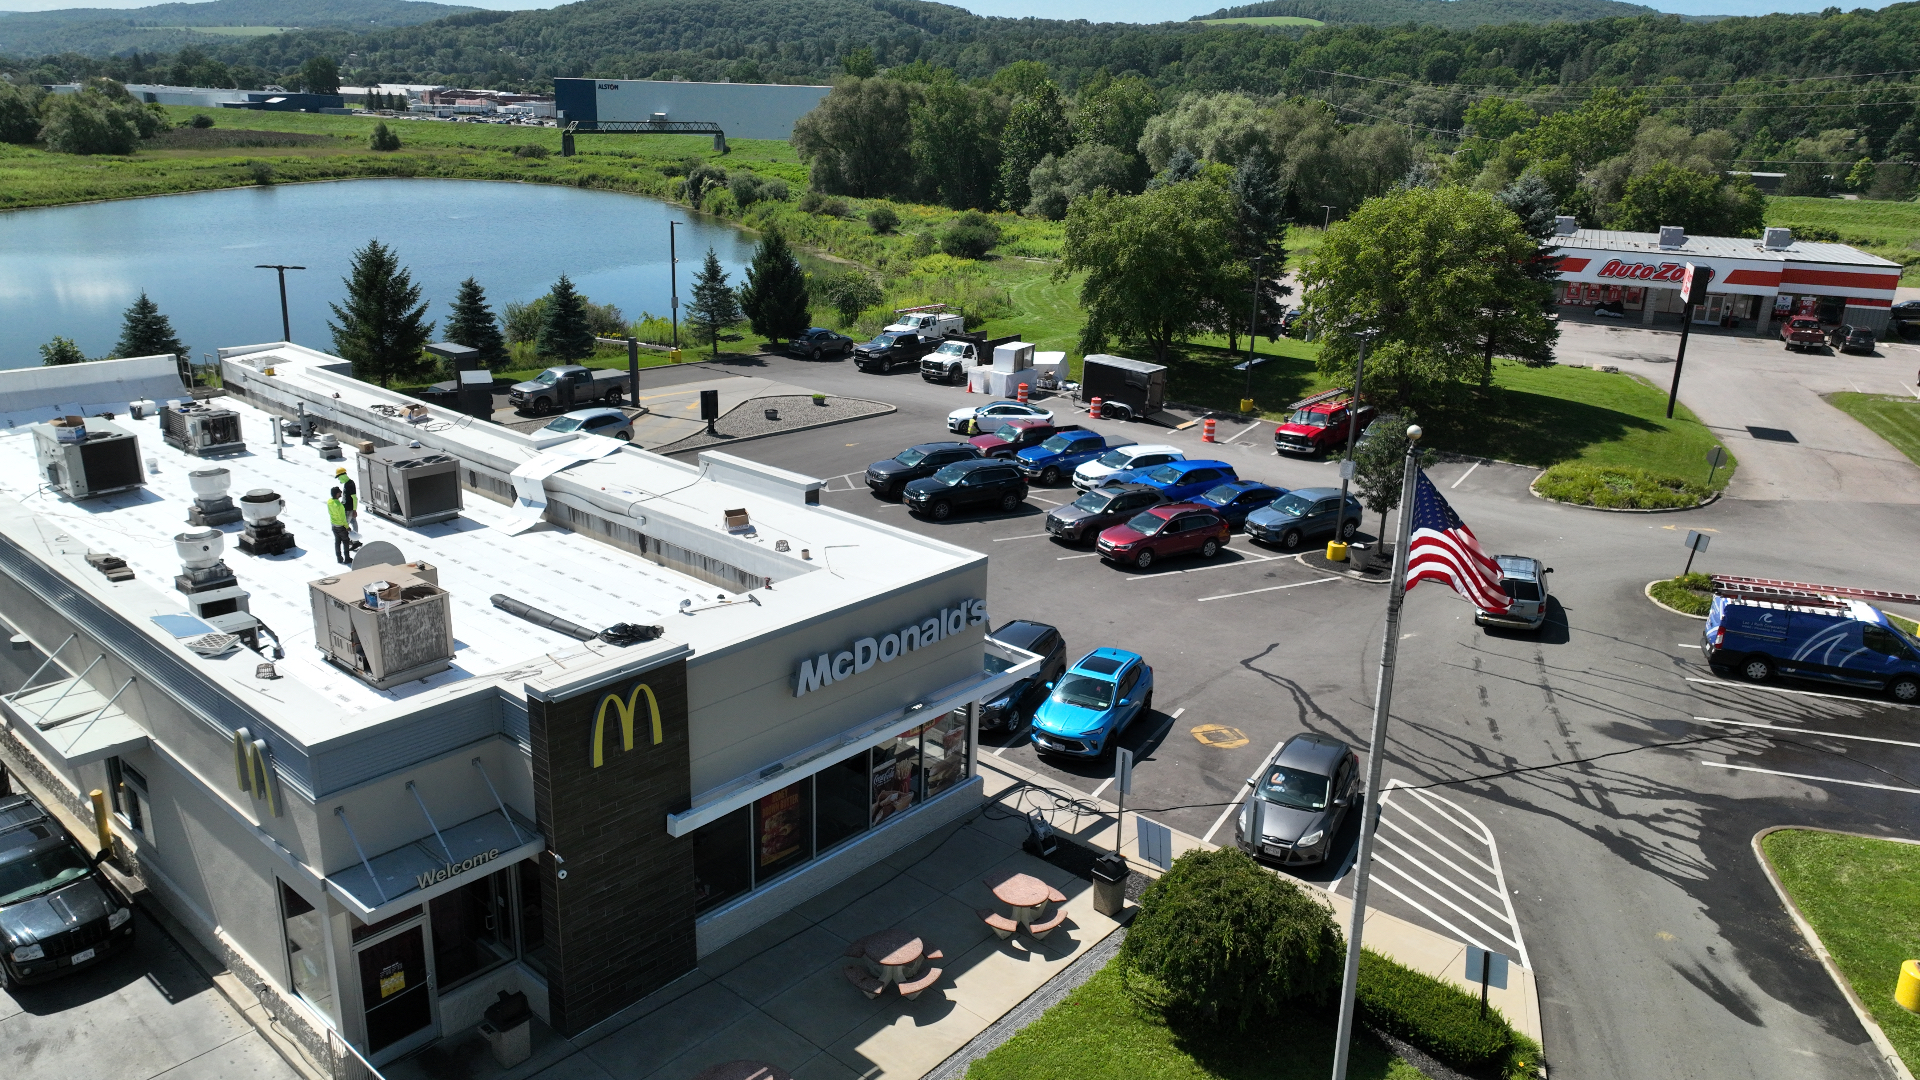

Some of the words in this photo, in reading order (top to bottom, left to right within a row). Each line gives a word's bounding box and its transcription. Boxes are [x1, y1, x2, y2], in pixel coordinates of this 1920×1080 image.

[1598, 258, 1715, 283] AutoZo
[790, 599, 988, 698] McDonald's
[416, 848, 499, 890] Welcome
